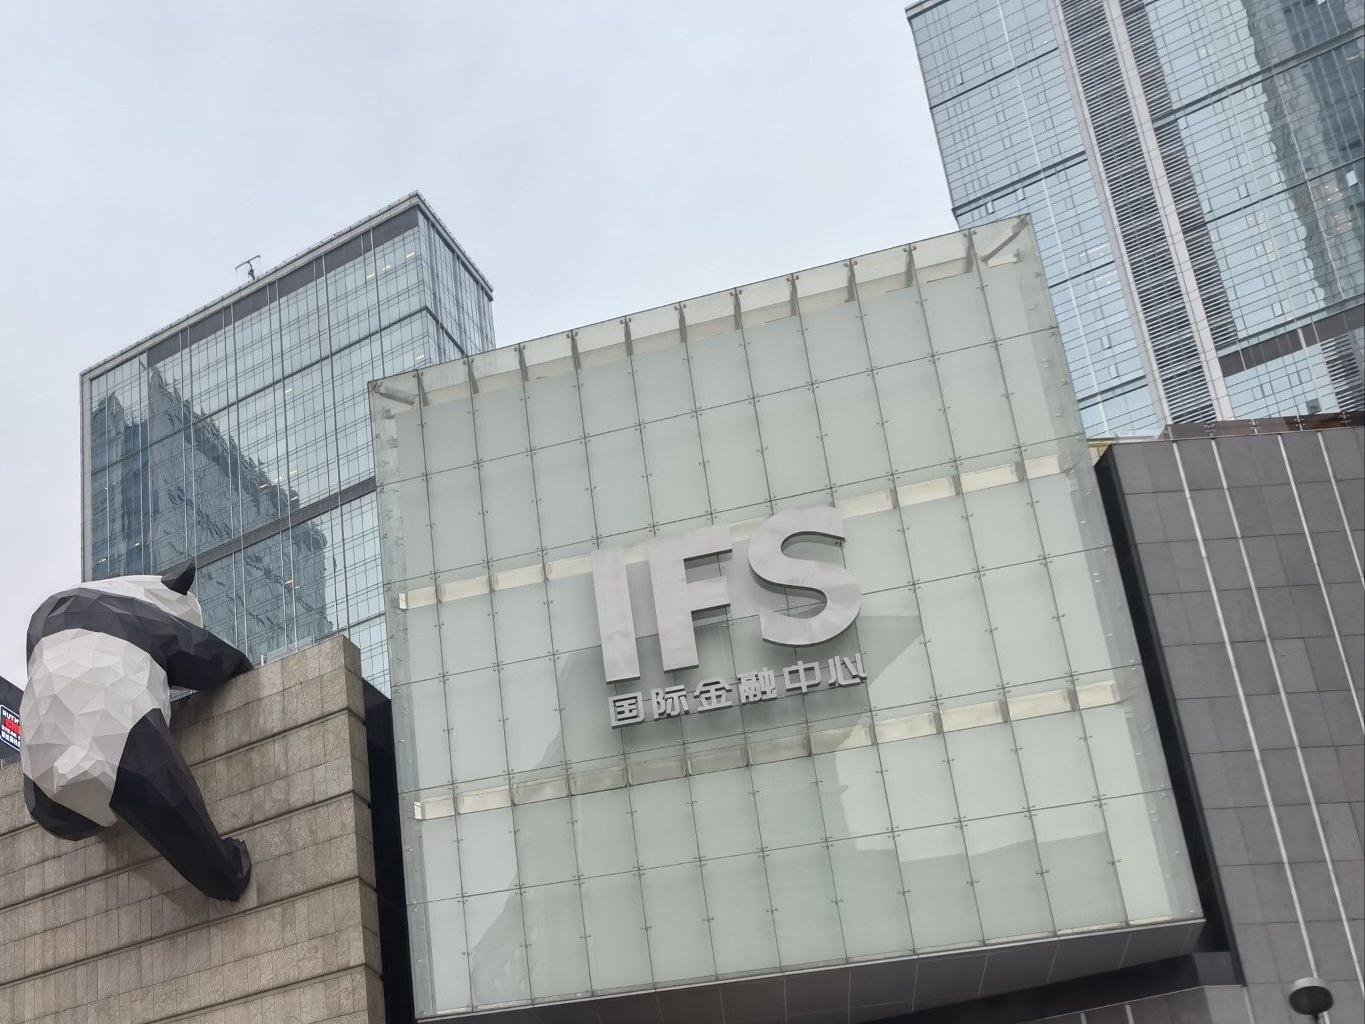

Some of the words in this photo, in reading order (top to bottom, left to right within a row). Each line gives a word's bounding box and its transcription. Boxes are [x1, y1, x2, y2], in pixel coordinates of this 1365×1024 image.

[591, 505, 863, 684] IFS
[608, 652, 868, 730] 国际金融中心
